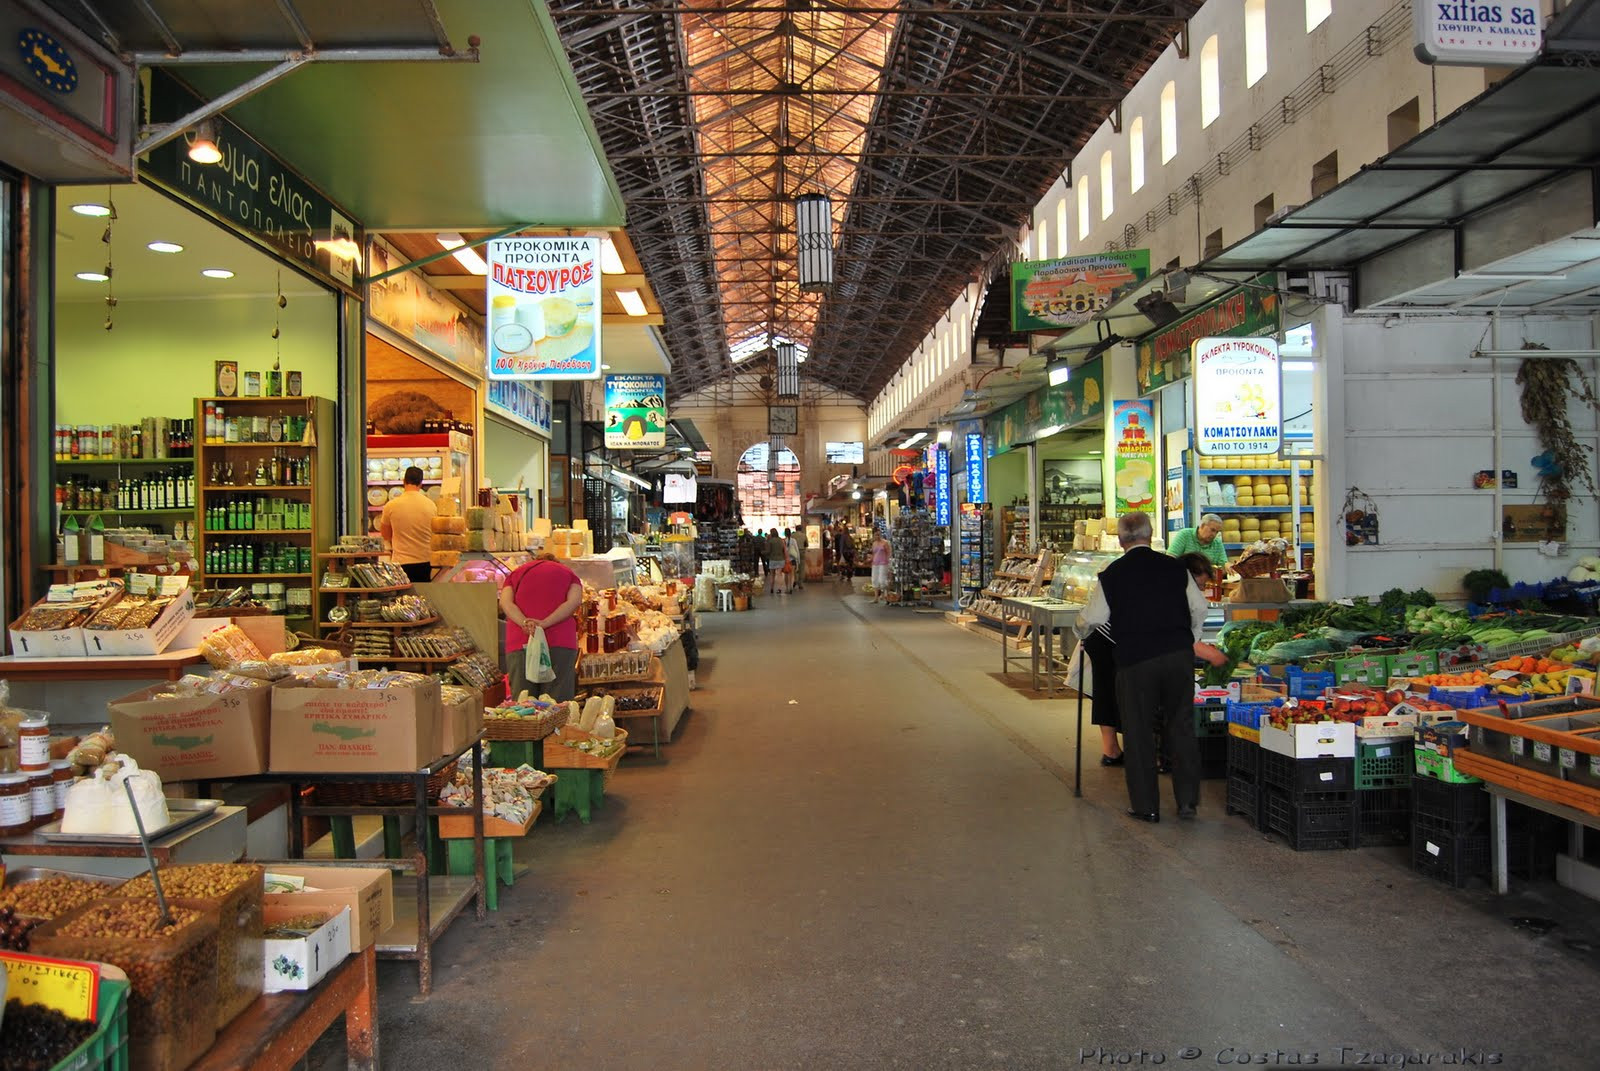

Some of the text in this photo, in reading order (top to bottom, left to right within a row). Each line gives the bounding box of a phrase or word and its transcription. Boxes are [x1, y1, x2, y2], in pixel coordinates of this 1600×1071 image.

[1438, 1, 1536, 25] xifias sa
[1438, 24, 1536, 36] ΙΧΘΥΗΡΑ ΚΑΒΑΛΑΣ
[495, 241, 590, 251] ΤΥΡΟΚΟΜΙΚΑ
[1024, 253, 1137, 270] Cretan Traditional Products
[492, 260, 594, 294] ΠΑΤΣΟΥΡΟΣ
[1201, 341, 1276, 364] ΕΚΛΕΚΤΑ ΤΥΡΟΚΟΜΙΚΑ
[496, 357, 515, 370] 100
[607, 381, 662, 390] ΤΥΡΟΚΟΜΙΚΑ
[1204, 426, 1278, 438] ΚΟΜΑΤΣΟΥΛΑΚΗ
[1211, 443, 1231, 451] ΑΠΟ
[1248, 442, 1268, 450] 1914
